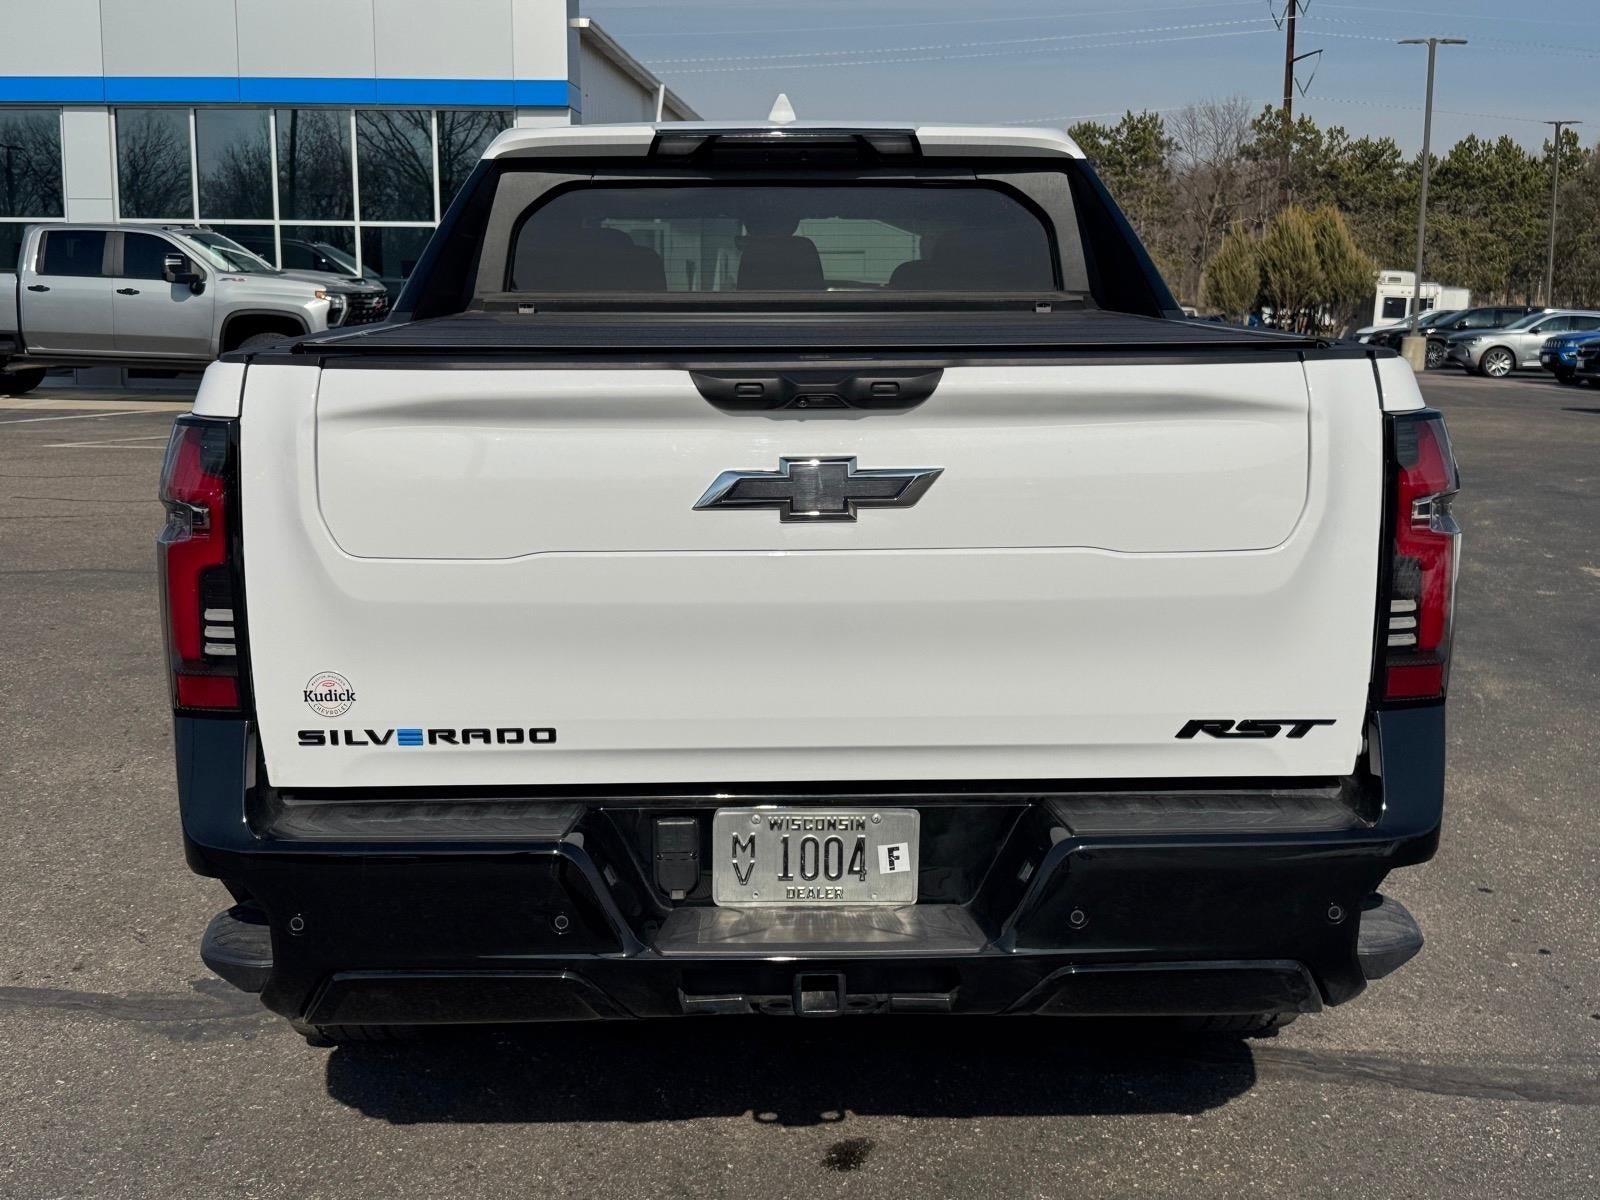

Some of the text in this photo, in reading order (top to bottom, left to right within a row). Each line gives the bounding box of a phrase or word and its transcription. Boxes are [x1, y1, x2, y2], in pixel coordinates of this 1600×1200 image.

[303, 689, 356, 702] Kudick
[313, 702, 349, 715] CHEVROLET
[297, 727, 558, 747] SILVERADO
[1174, 718, 1337, 740] RST
[768, 816, 867, 831] WISCONSIN
[777, 834, 868, 882] 1004
[887, 846, 901, 871] F
[786, 886, 844, 900] DEALER
